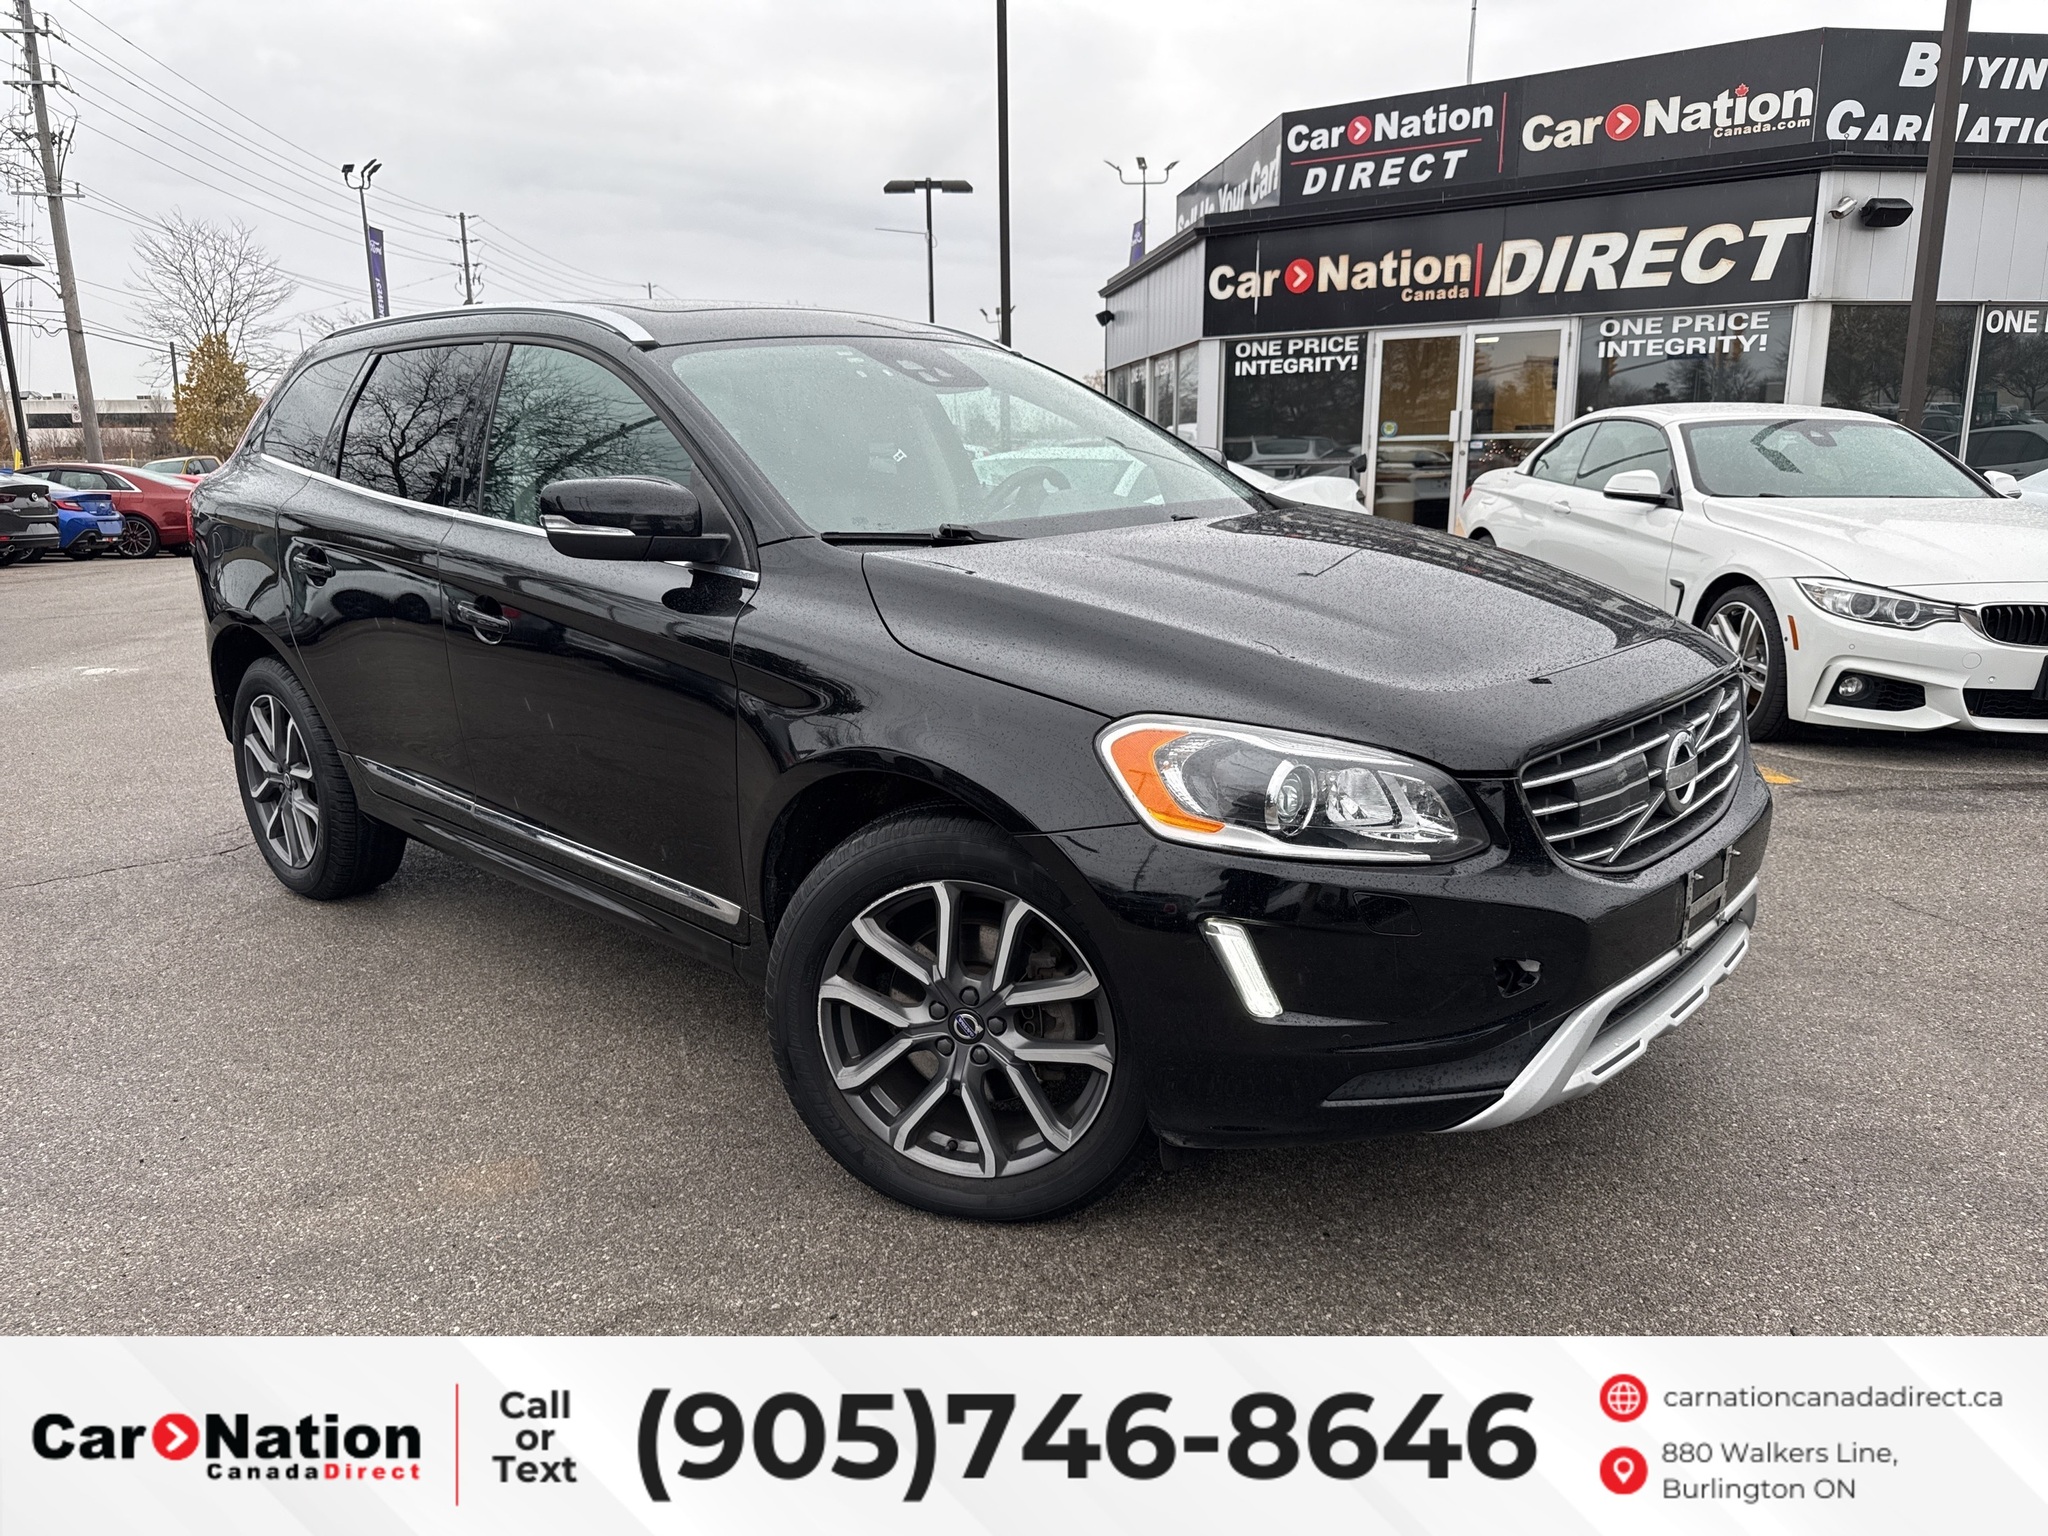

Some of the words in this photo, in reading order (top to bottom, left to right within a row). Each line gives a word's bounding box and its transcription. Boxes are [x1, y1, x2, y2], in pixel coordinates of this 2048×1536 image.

[1287, 123, 1345, 153] Car
[1373, 104, 1494, 142] Nation
[1522, 115, 1604, 152] Car
[1644, 86, 1814, 138] Nation
[1713, 117, 1811, 138] Canada.com
[1302, 149, 1468, 196] DIRECT
[1209, 265, 1281, 301] Car
[1318, 248, 1471, 293] Nation
[1485, 216, 1813, 298] DIRECT
[1401, 285, 1470, 302] Canada
[1599, 316, 1665, 338] ONE
[1672, 311, 1771, 334] PRICE
[1986, 309, 2040, 334] ONE
[1235, 340, 1283, 358] ONE
[1288, 336, 1359, 355] PRICE
[1598, 335, 1767, 359] INTEGRITY!
[1235, 355, 1358, 377] INTEGRITY!
